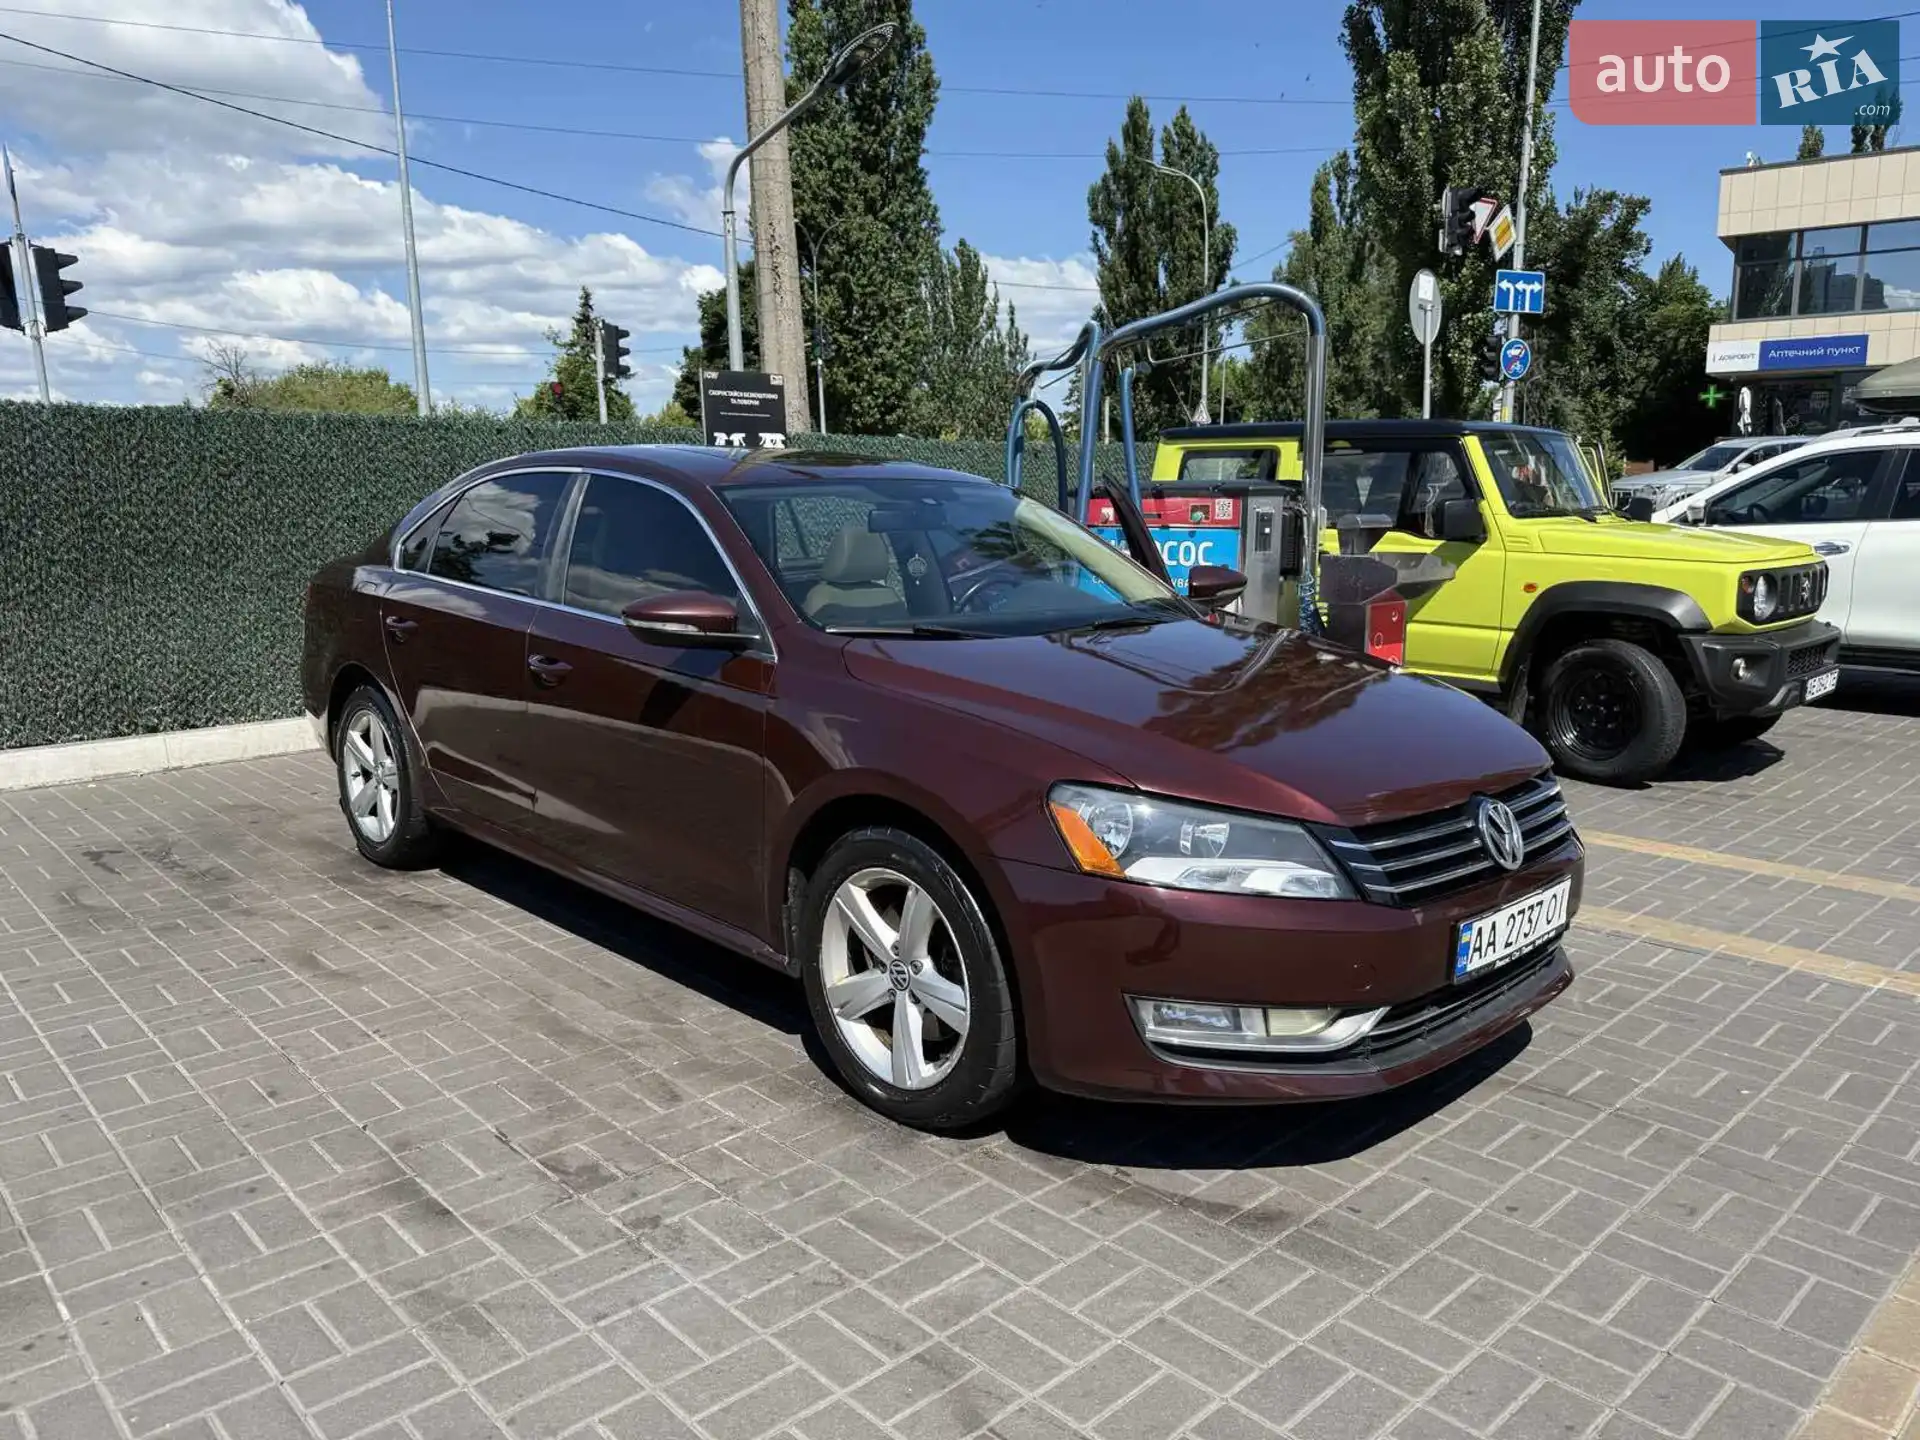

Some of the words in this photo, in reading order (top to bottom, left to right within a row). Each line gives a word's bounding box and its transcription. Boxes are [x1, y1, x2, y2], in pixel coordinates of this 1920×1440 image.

[1768, 347, 1824, 359] Аптечний
[1826, 346, 1861, 356] пункт
[1469, 921, 1496, 964] AA
[1504, 900, 1544, 949] 2737
